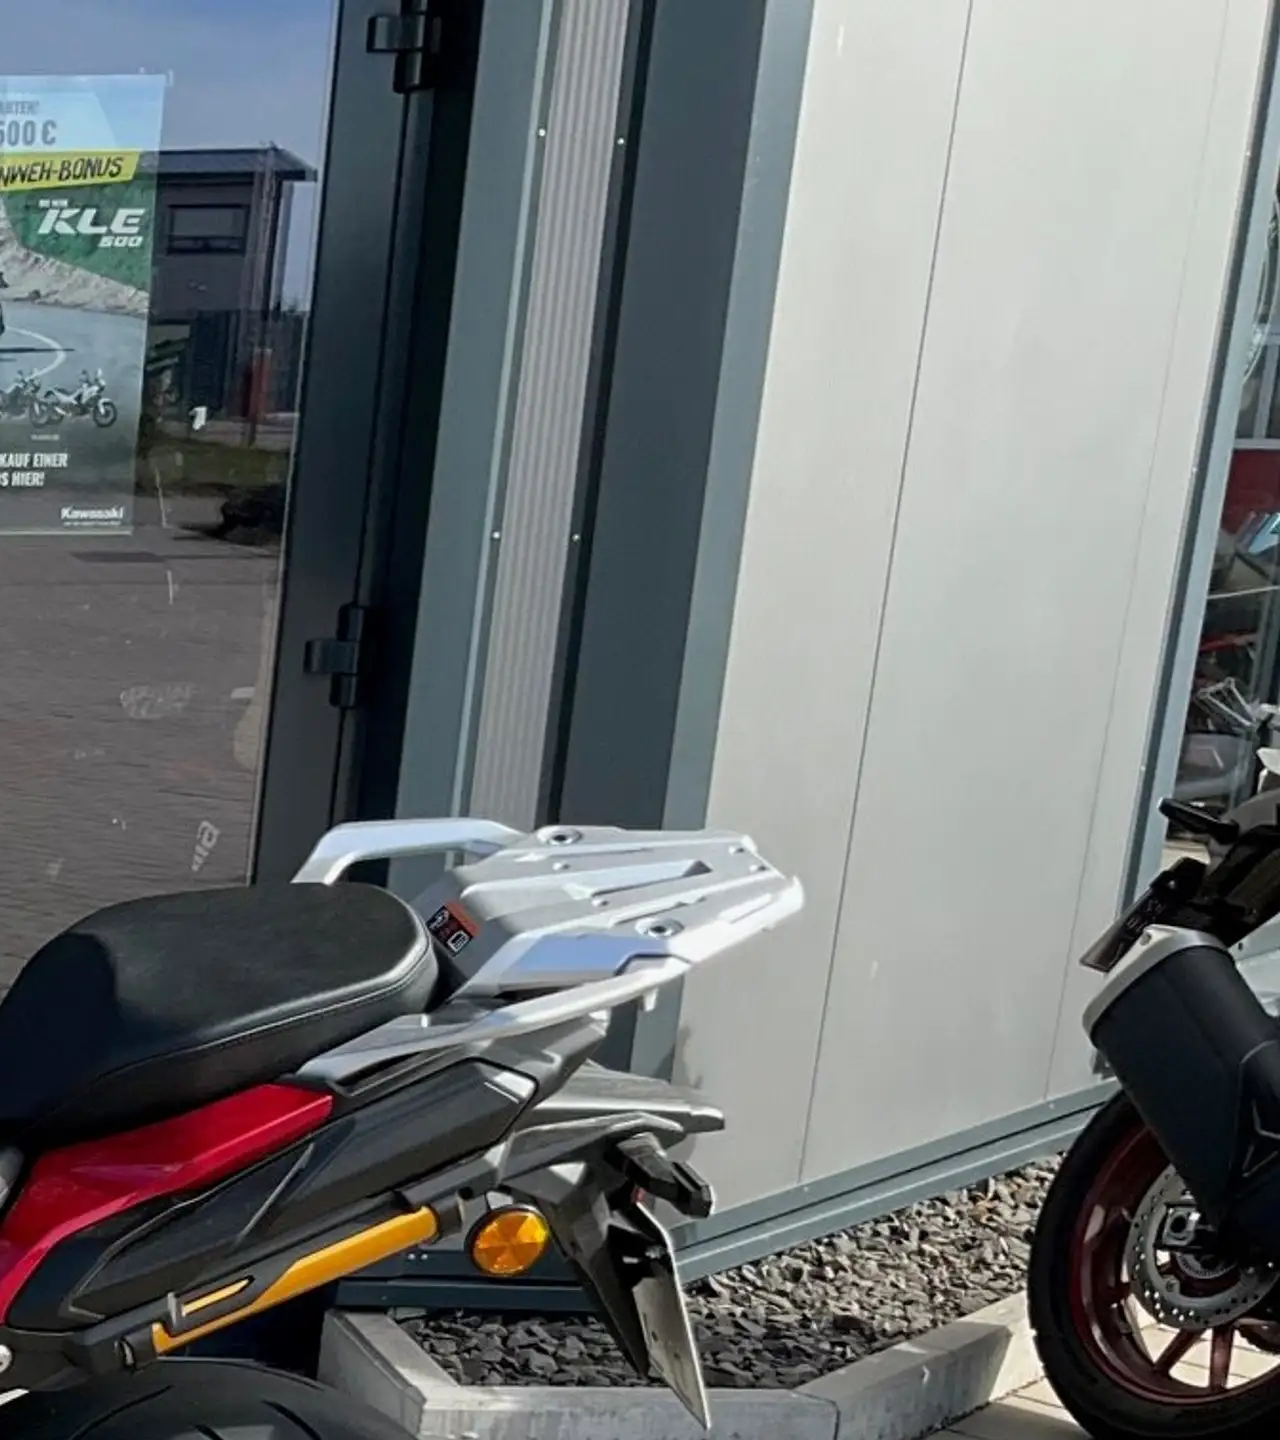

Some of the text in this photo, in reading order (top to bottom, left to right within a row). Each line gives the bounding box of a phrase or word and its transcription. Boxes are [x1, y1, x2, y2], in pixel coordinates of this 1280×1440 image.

[42, 119, 57, 146] €
[37, 208, 146, 235] KLE
[33, 453, 68, 468] EINER
[61, 506, 124, 520] Kawasaki
